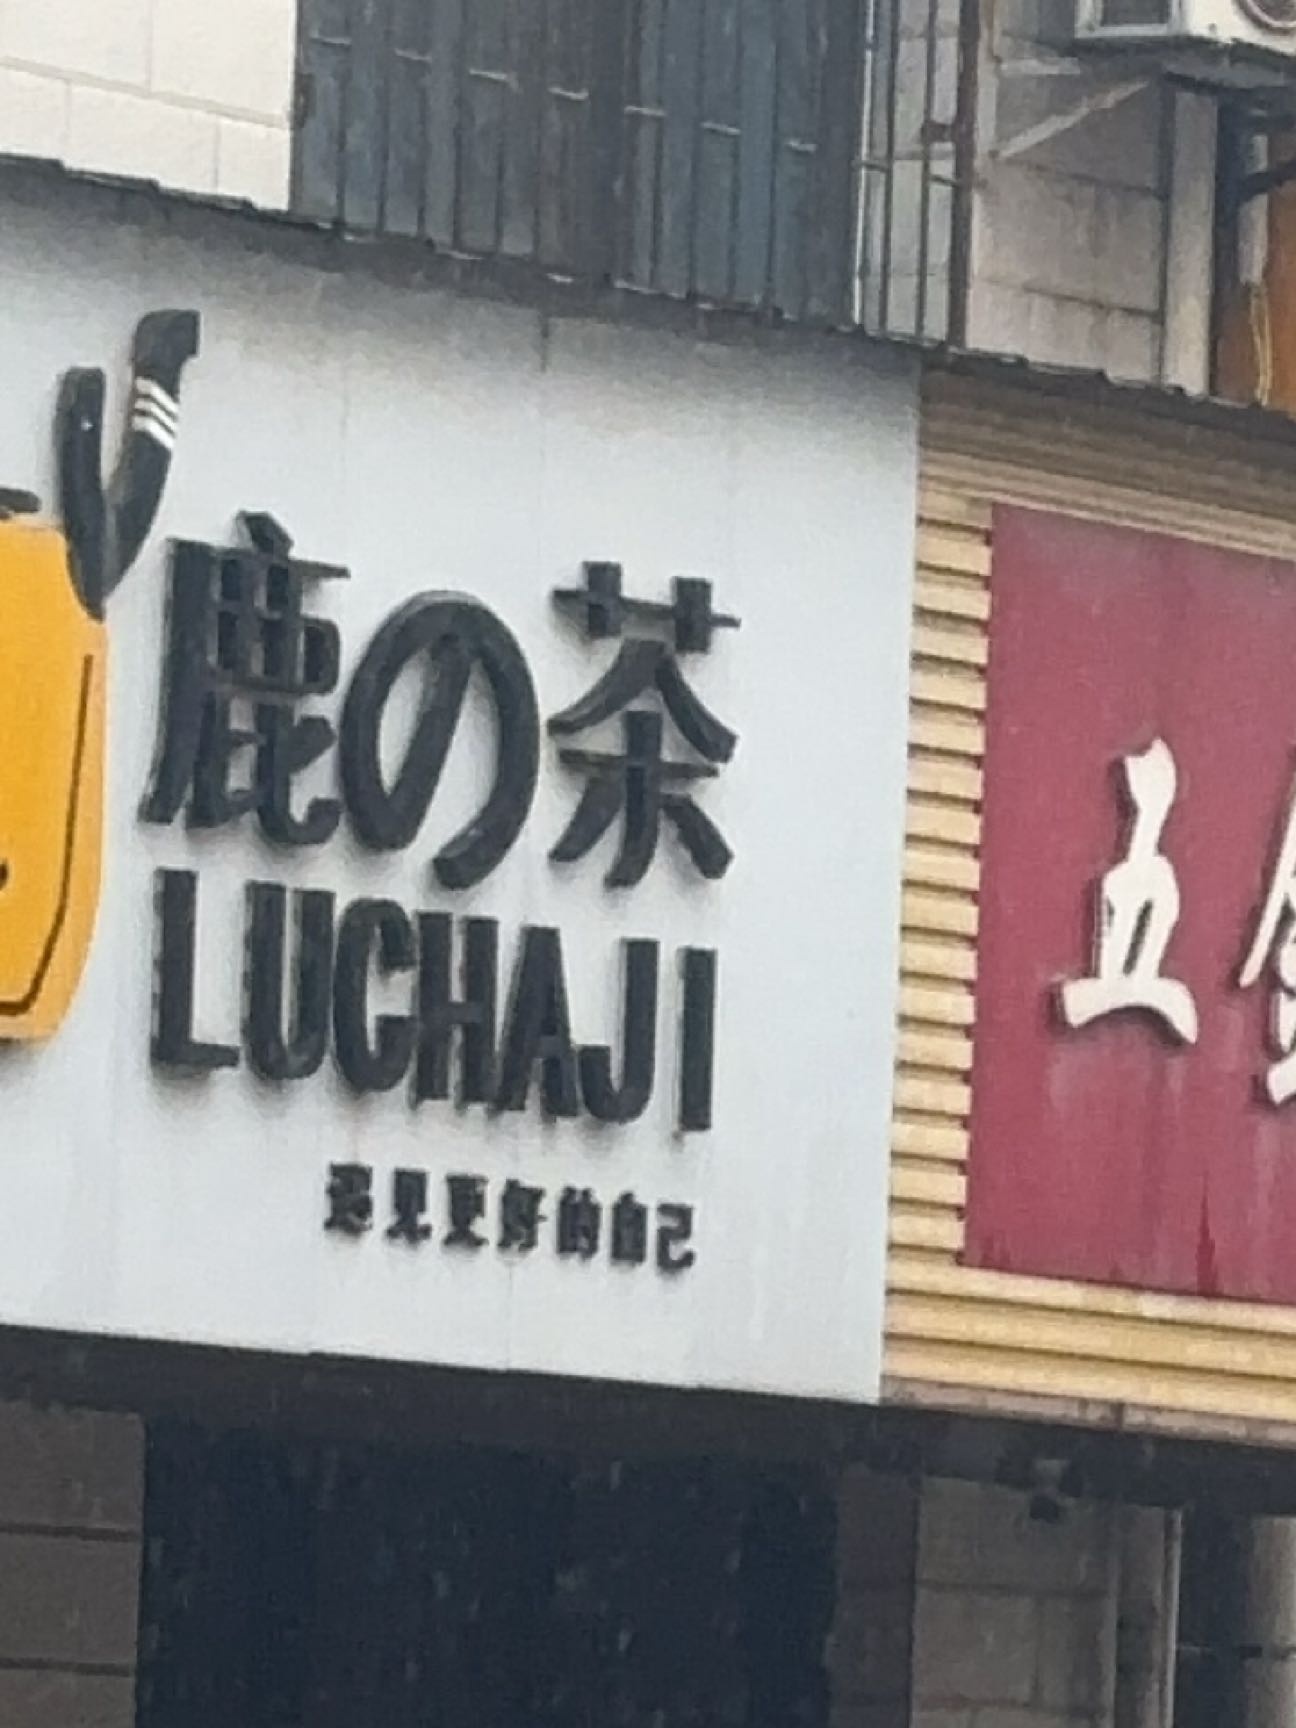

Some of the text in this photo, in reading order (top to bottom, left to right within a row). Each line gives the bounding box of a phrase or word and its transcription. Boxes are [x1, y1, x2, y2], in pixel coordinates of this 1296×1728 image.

[141, 511, 740, 889] 鹿の茶
[152, 868, 717, 1132] LUCHAJI
[324, 1163, 695, 1270] 遇见更好的自己
